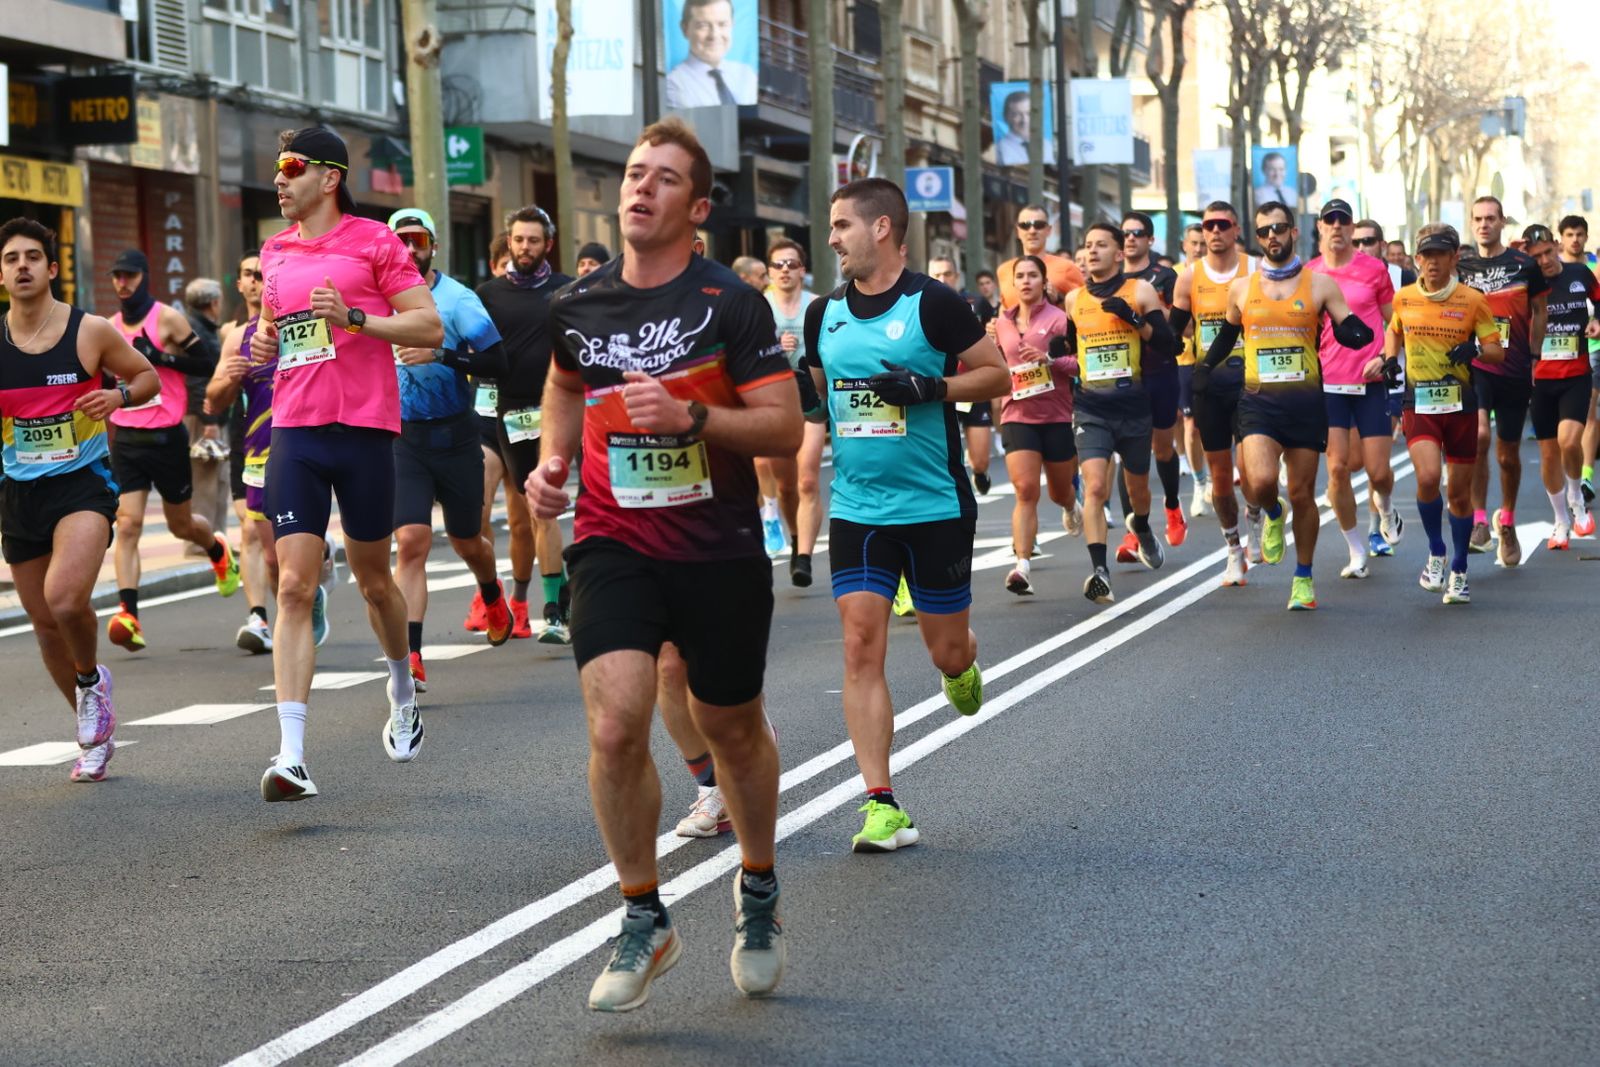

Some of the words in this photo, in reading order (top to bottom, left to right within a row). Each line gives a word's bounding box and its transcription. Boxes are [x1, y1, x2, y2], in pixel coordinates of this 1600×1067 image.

[71, 96, 129, 122] METRO
[283, 322, 317, 343] 2127
[1550, 338, 1570, 347] 612
[576, 335, 695, 373] Salamanca
[1097, 352, 1119, 363] 155
[1270, 355, 1293, 366] 135
[46, 372, 78, 386] 226ERS
[1017, 368, 1043, 383] 2595
[850, 392, 884, 409] 542
[1427, 387, 1450, 398] 142
[22, 426, 63, 443] 2091
[626, 451, 690, 472] 1194
